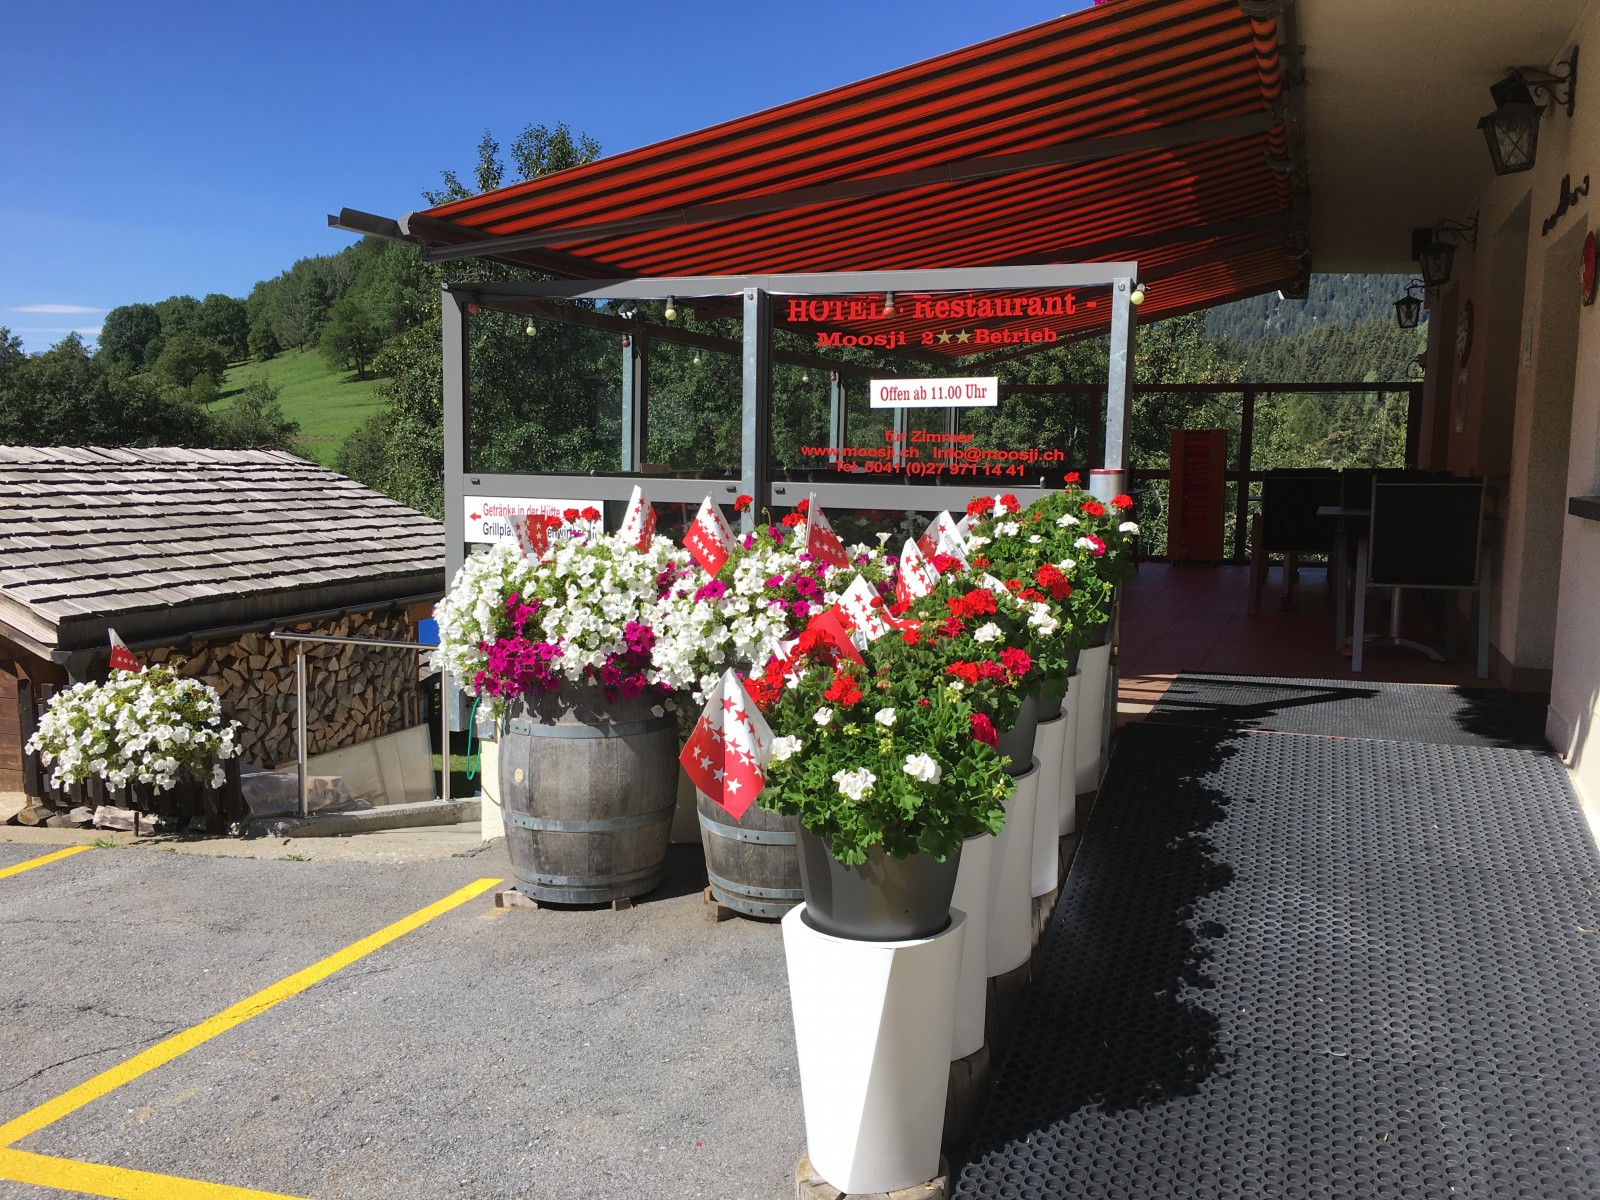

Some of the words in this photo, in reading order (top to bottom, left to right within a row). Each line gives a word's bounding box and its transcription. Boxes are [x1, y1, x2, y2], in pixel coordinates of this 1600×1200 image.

[788, 297, 886, 322] HOTEL
[913, 293, 1076, 319] Restaurant
[817, 331, 907, 349] Moosji
[921, 331, 934, 345] 2
[974, 328, 1057, 344] Betrieb
[880, 386, 910, 401] Offen
[913, 386, 927, 400] ab
[931, 386, 962, 400] 11.00
[965, 384, 987, 399] Uhr
[885, 430, 907, 442] für
[910, 431, 974, 443] Zimmer
[801, 446, 920, 460] www.moosji.ch
[864, 462, 900, 474] 0041
[906, 462, 944, 476] (0)27
[949, 463, 977, 476] 971
[983, 464, 1002, 476] 14
[1006, 464, 1025, 477] 41
[483, 503, 516, 517] Getränke
[518, 505, 525, 516] in
[527, 505, 539, 516] der
[541, 505, 561, 517] Hütte
